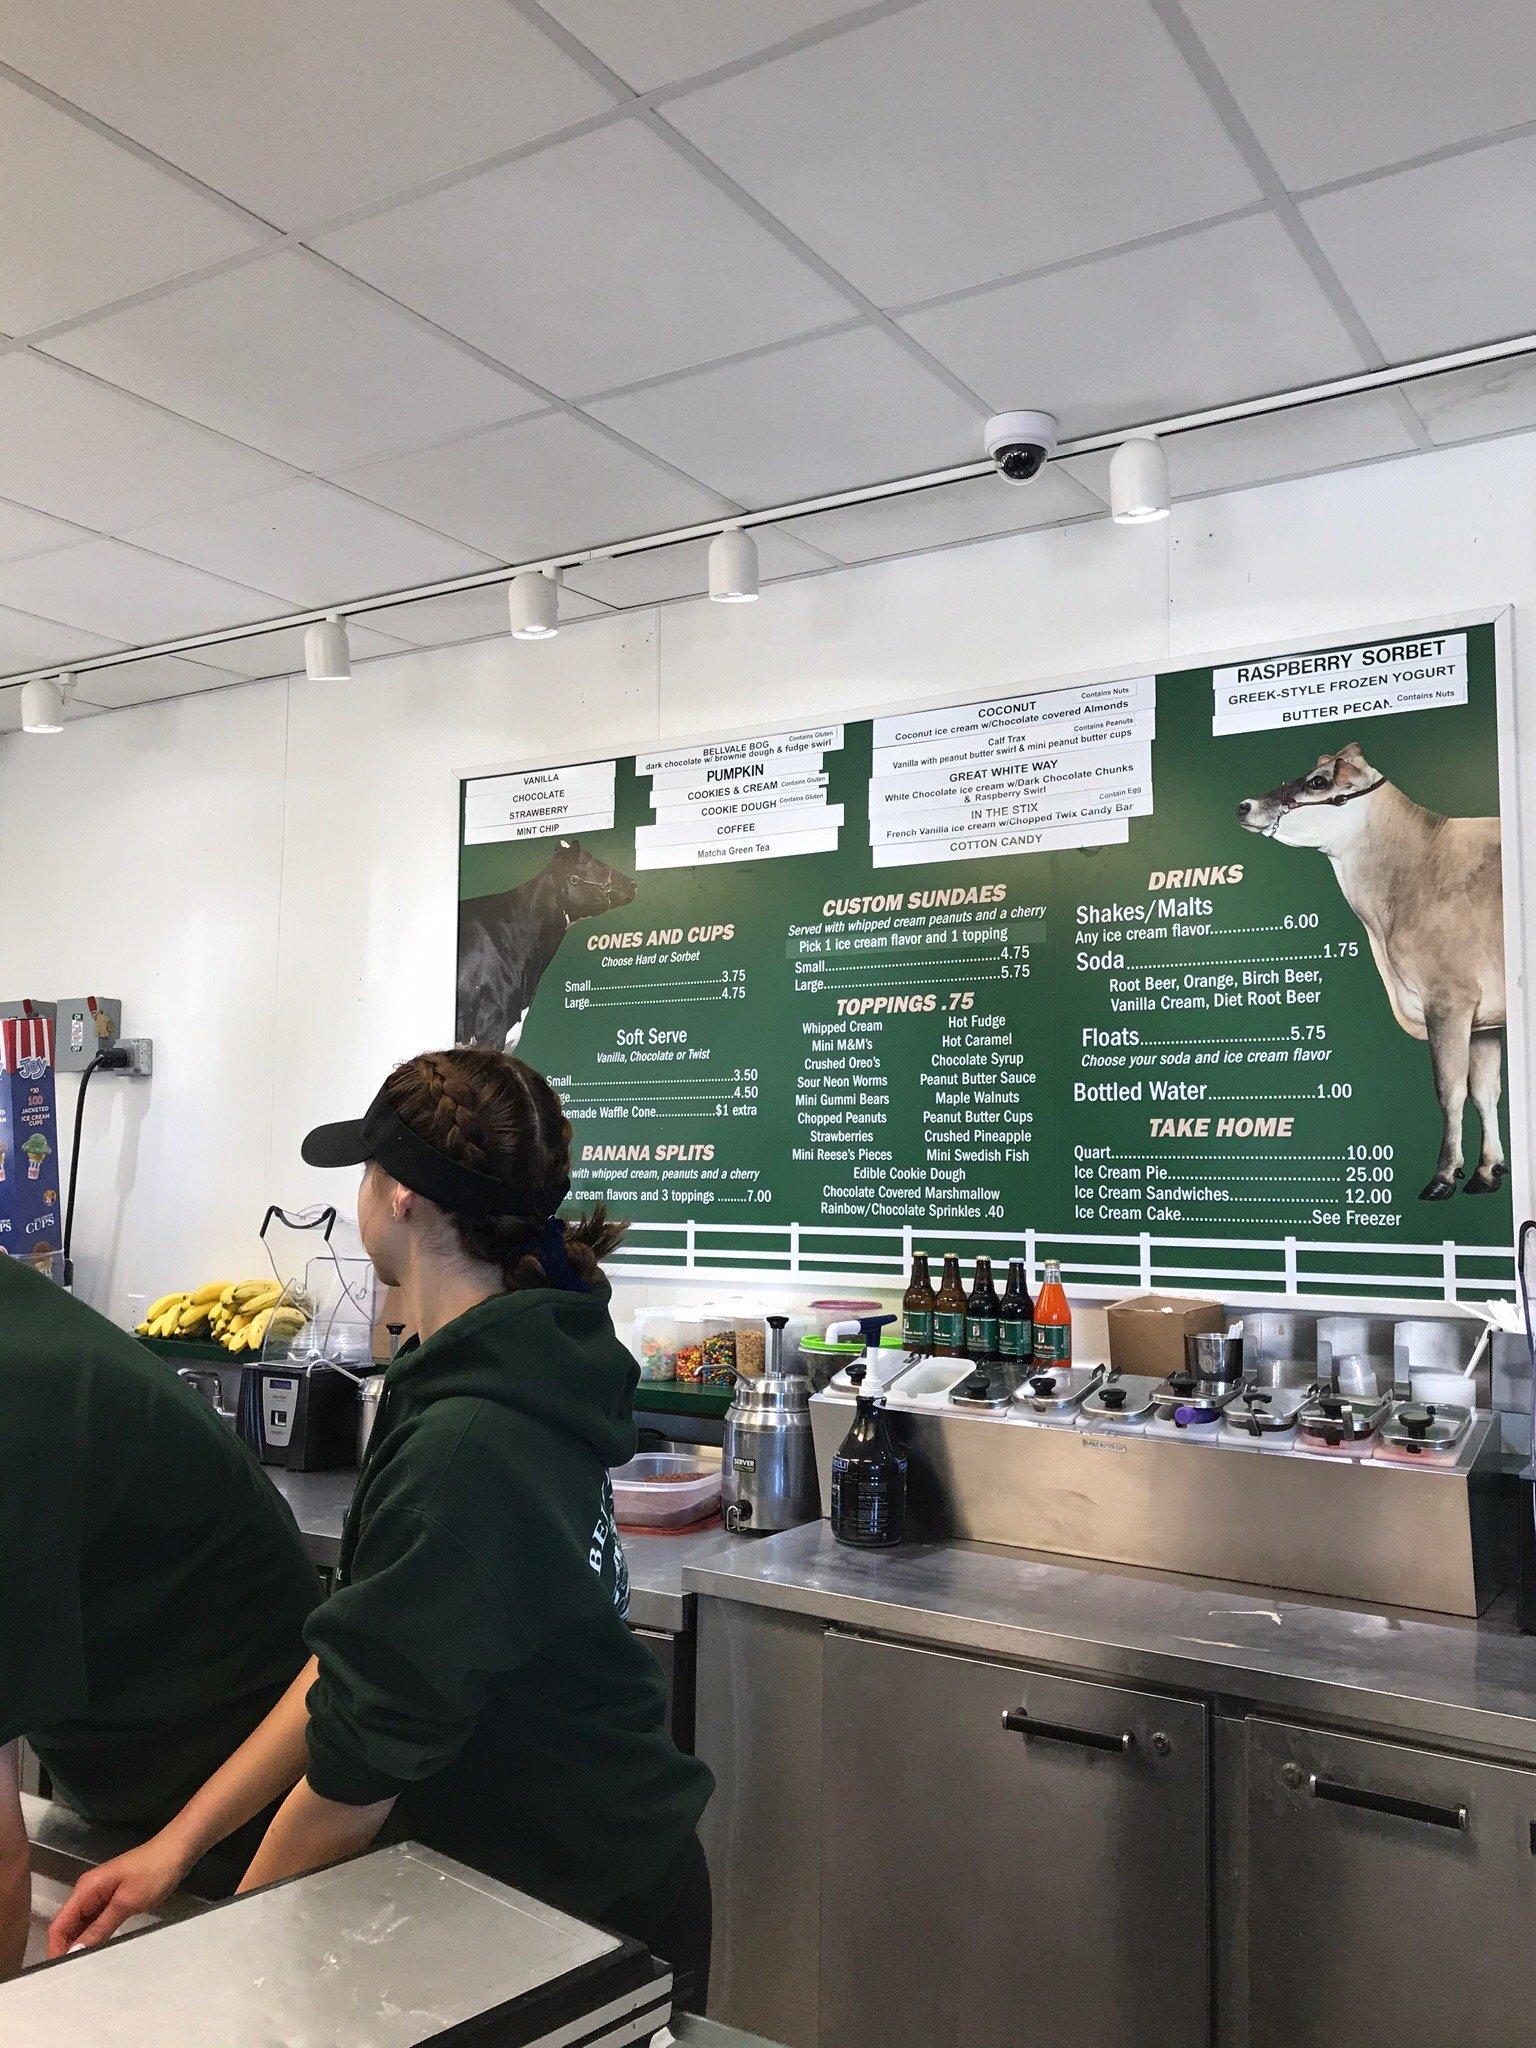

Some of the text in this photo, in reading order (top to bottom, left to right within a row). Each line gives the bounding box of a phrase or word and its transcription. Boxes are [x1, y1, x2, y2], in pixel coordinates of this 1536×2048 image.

[1237, 640, 1446, 683] RASPBERRY SORBET
[1228, 665, 1455, 705] GREEK-STYLE FROZEN YOGURT
[1081, 691, 1111, 699] Contains
[1397, 693, 1433, 701] Contains
[978, 702, 1037, 718] COCONUT
[1283, 706, 1338, 722] BUTTER
[895, 730, 932, 740] Coconut
[951, 724, 978, 733] cream
[981, 714, 1039, 730] w/Chocolate
[1042, 707, 1080, 720] covered
[1084, 701, 1128, 713] Almonds
[703, 741, 769, 756] BELLVALE BOG
[988, 736, 1005, 746] Calf
[707, 764, 763, 782] PUMPKIN
[949, 760, 1058, 782] GREAT WHITE WAY
[524, 774, 559, 785] VANILLA
[885, 794, 909, 802] White
[912, 788, 956, 798] Chocolate
[976, 783, 1004, 792] cream
[1007, 777, 1039, 788] w/Dark
[1043, 771, 1092, 783] Chocolate
[1096, 765, 1133, 776] Chunks
[513, 790, 564, 802] CHOCOLATE
[688, 781, 778, 800] COOKIES & CREAM
[510, 805, 568, 819] STRAWBERRY
[702, 800, 776, 816] COOKIE DOUGH
[972, 803, 1038, 819] IN THE STIX
[517, 824, 559, 835] MINT CHIP
[717, 823, 755, 834] COFFEE
[950, 834, 1042, 851] COTTON CANDY
[698, 844, 770, 858] Matcha Green Tea
[1148, 864, 1244, 890] DRINKS
[823, 884, 1006, 916] CUSTOM SUNDAES
[1077, 897, 1213, 924] Shakes/Malts
[588, 924, 734, 950] CONES AND CUPS
[1075, 913, 1318, 946] Any ice cream flavor 6.00
[602, 951, 700, 967] Choose Hard or Sorbet
[795, 946, 1029, 973] Small 4.75
[1077, 942, 1358, 971] Soda 1.75
[565, 970, 746, 992] Small 3.75
[795, 964, 1030, 993] Large 5.75
[1110, 969, 1322, 992] Root Beer, Orange, Birch Beer,
[565, 987, 745, 1010] Large 4.75
[837, 992, 974, 1016] TOPPINGS .75
[802, 1021, 882, 1036] Whipped Cream
[949, 1015, 1006, 1029] Hot Fudge
[617, 1028, 687, 1045] Soft Serve
[943, 1033, 1012, 1047] Hot Caramel
[1083, 1025, 1325, 1046] Floats 5.75
[812, 1038, 872, 1051] Mini M&M's
[598, 1048, 710, 1063] Vanilla, Chocolate or Twist
[805, 1056, 880, 1070] Crushed Oreo's
[932, 1052, 1023, 1067] Chocolate Syrup
[546, 1069, 758, 1086] Small 3.50
[798, 1075, 888, 1088] Sour Neon Worms
[936, 1091, 1019, 1106] Maple Walnuts
[1074, 1081, 1352, 1101] Bottled Water 1.00
[798, 1112, 887, 1126] Chopped Peanuts
[1150, 1118, 1294, 1137] TAKE HOME
[810, 1130, 873, 1142] Strawberries
[925, 1130, 1031, 1144] Crushed Pineapple
[582, 1144, 714, 1160] BANANA SPLITS
[1074, 1145, 1393, 1161] Quart 10.00
[1075, 1165, 1393, 1182] Ice Cream Pie 25.00
[823, 1185, 1000, 1200] Chocolate Covered Marshmallow
[821, 1202, 1004, 1219] Rainbow/Chocolate Sprinkles .40
[1076, 1205, 1401, 1226] Ice Cream Cake See Freezer
[26, 1215, 54, 1234] CUPS
[734, 1458, 755, 1467] SERVER
